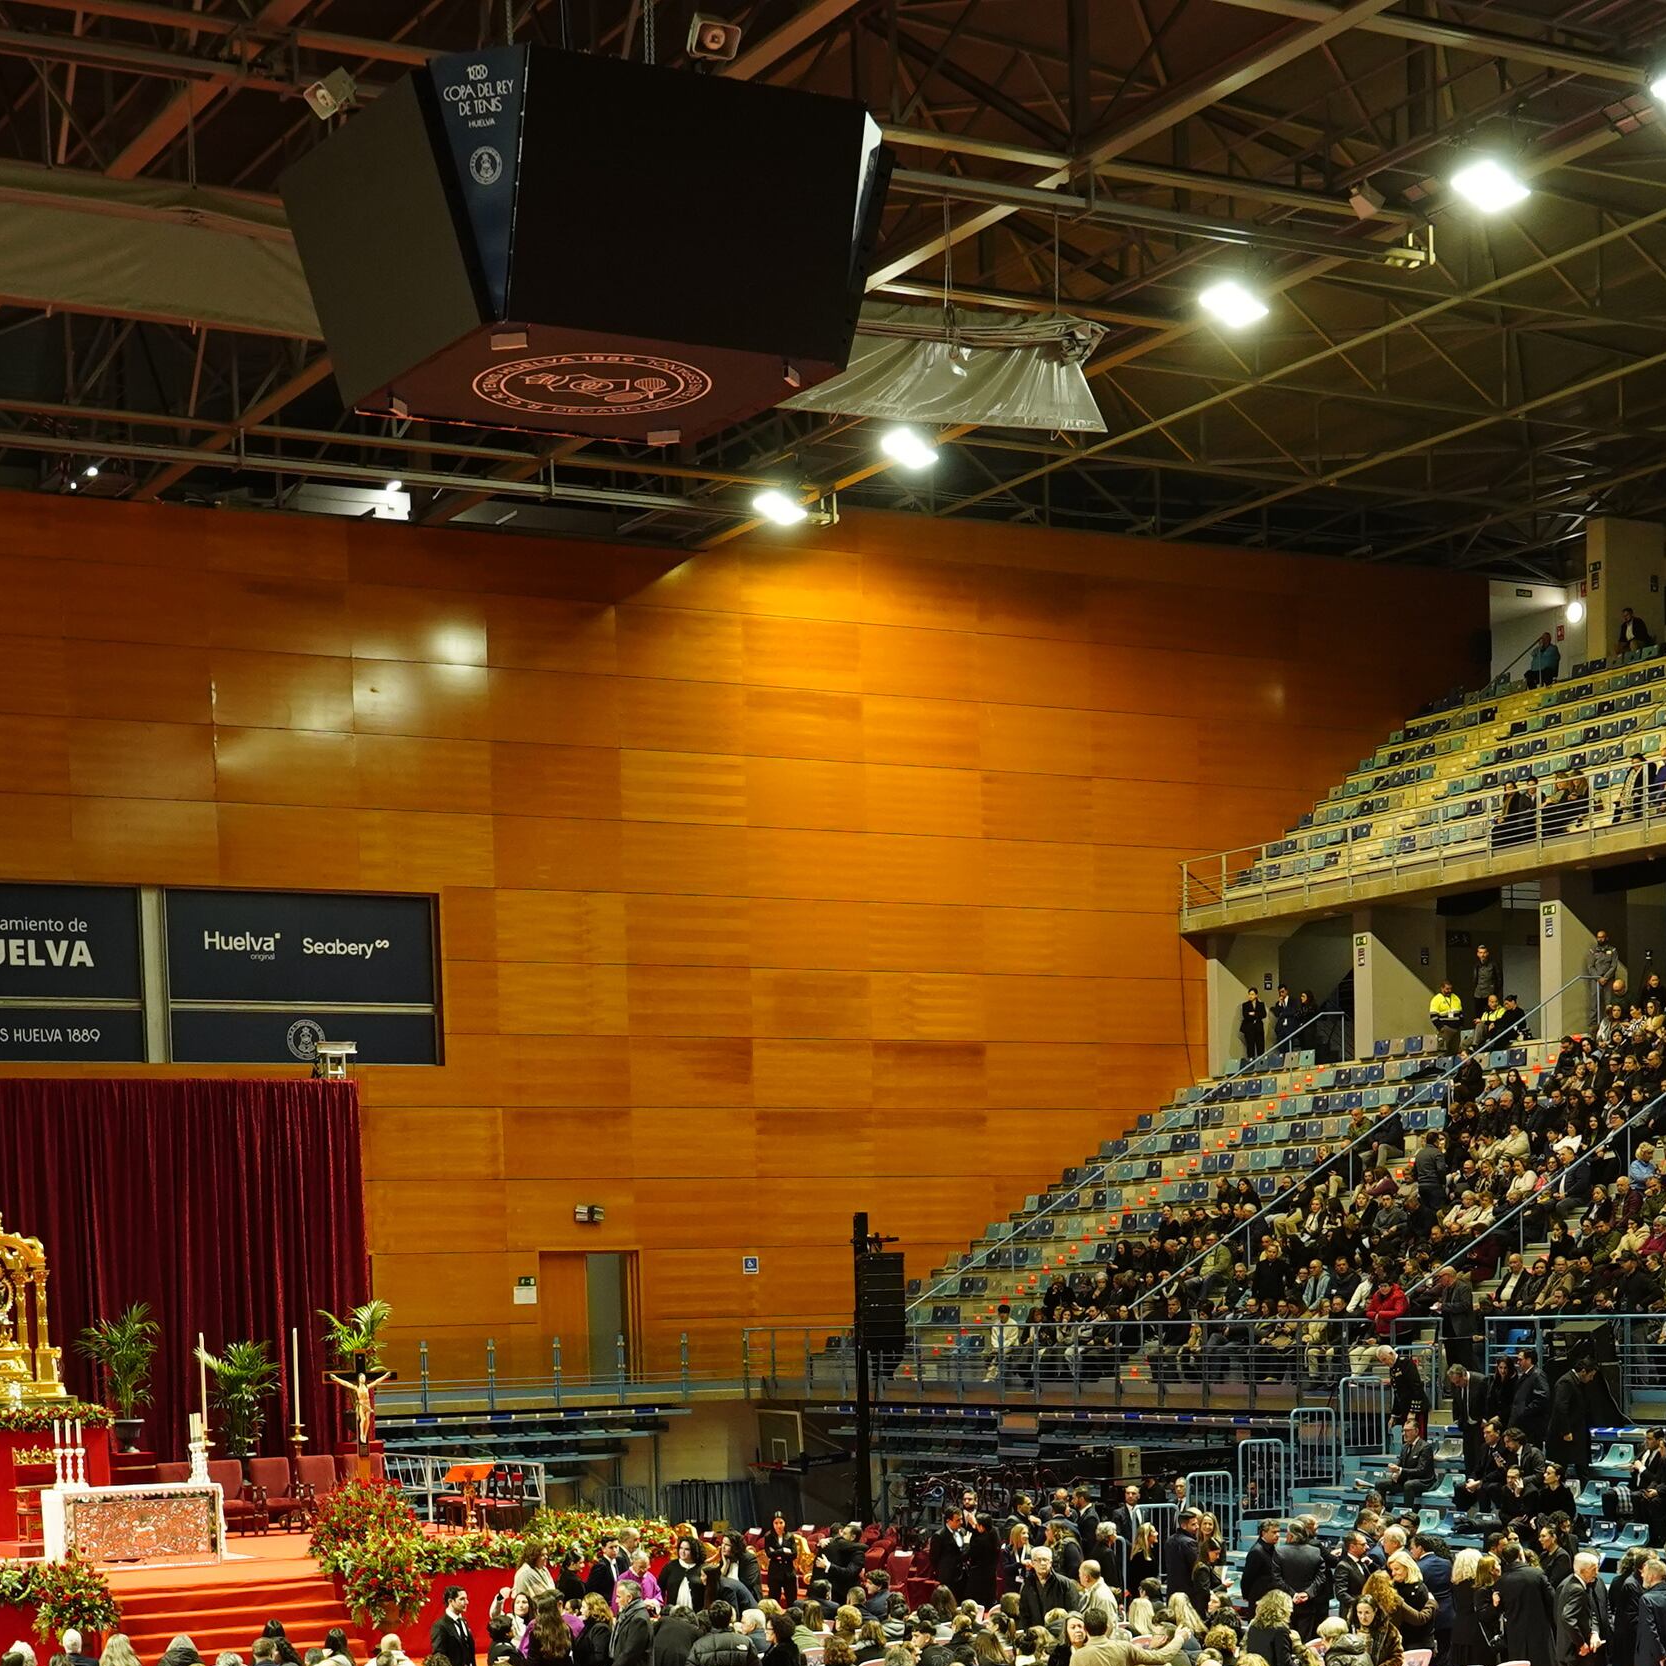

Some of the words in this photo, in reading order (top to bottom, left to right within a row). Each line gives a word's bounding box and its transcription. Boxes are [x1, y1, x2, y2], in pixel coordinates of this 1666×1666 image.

[444, 84, 475, 101] COPA
[477, 81, 495, 98] DEL
[497, 80, 513, 95] REY
[459, 101, 471, 116] DE
[474, 97, 502, 113] TENIS
[468, 118, 495, 128] HUELVA
[496, 357, 575, 375] HUELVA
[68, 919, 88, 933] de
[204, 930, 275, 951] Huelva
[302, 938, 374, 960] Seabery
[250, 952, 276, 962] original
[14, 1028, 63, 1042] HUELVA
[66, 1028, 101, 1043] 1889
